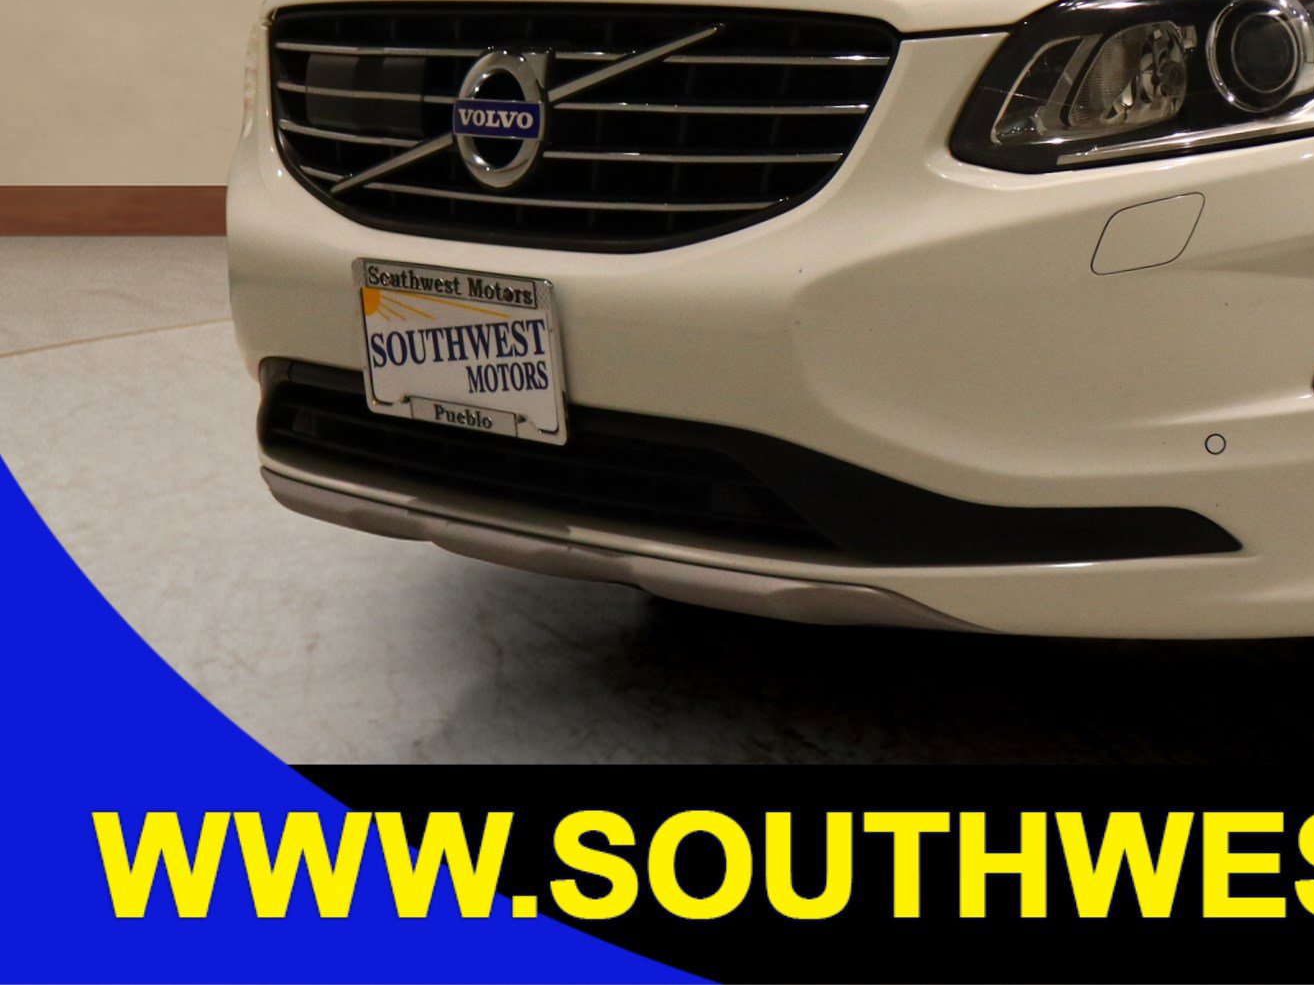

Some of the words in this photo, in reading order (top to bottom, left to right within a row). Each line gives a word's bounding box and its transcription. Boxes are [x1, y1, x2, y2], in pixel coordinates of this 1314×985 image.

[457, 108, 535, 130] VOLVO
[367, 266, 461, 296] Southwest
[467, 277, 534, 305] Motors
[370, 318, 547, 369] SOUTHWEST
[465, 360, 549, 394] MOTORS
[433, 404, 493, 430] Pueblo
